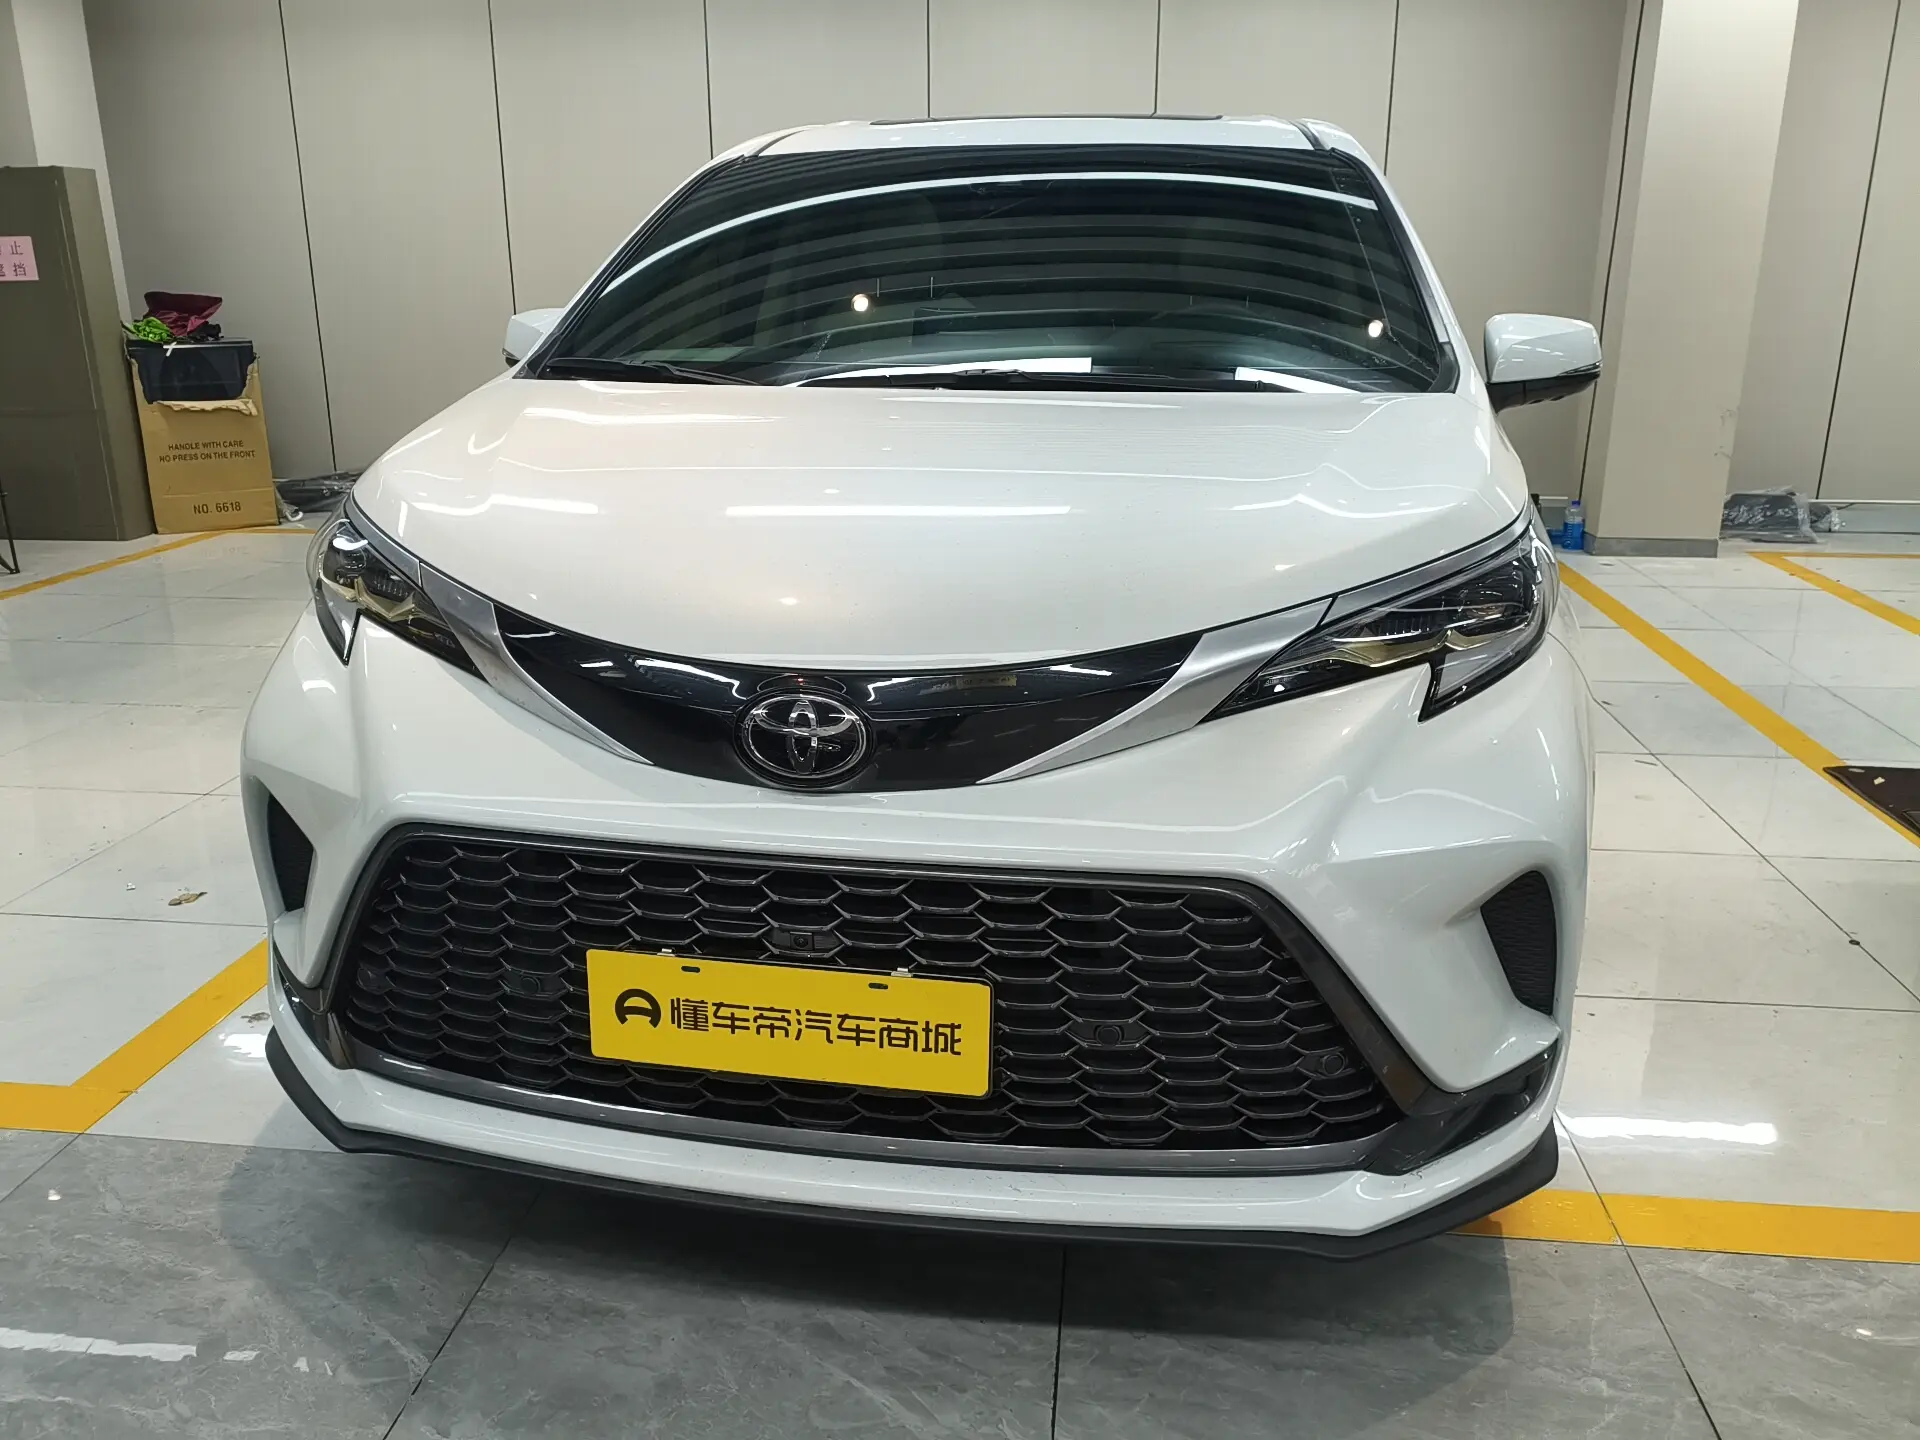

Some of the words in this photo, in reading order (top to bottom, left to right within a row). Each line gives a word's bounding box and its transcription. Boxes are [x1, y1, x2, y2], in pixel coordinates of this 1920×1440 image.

[168, 442, 200, 450] HANDLE
[202, 441, 221, 449] WITH
[222, 440, 244, 448] CARE
[159, 455, 171, 463] NO
[172, 453, 198, 461] PRESS
[200, 452, 212, 460] ON
[230, 450, 255, 458] FRONT
[193, 503, 213, 515] NO.
[215, 501, 241, 513] 6618
[669, 996, 963, 1057] 懂车帝汽车商城
